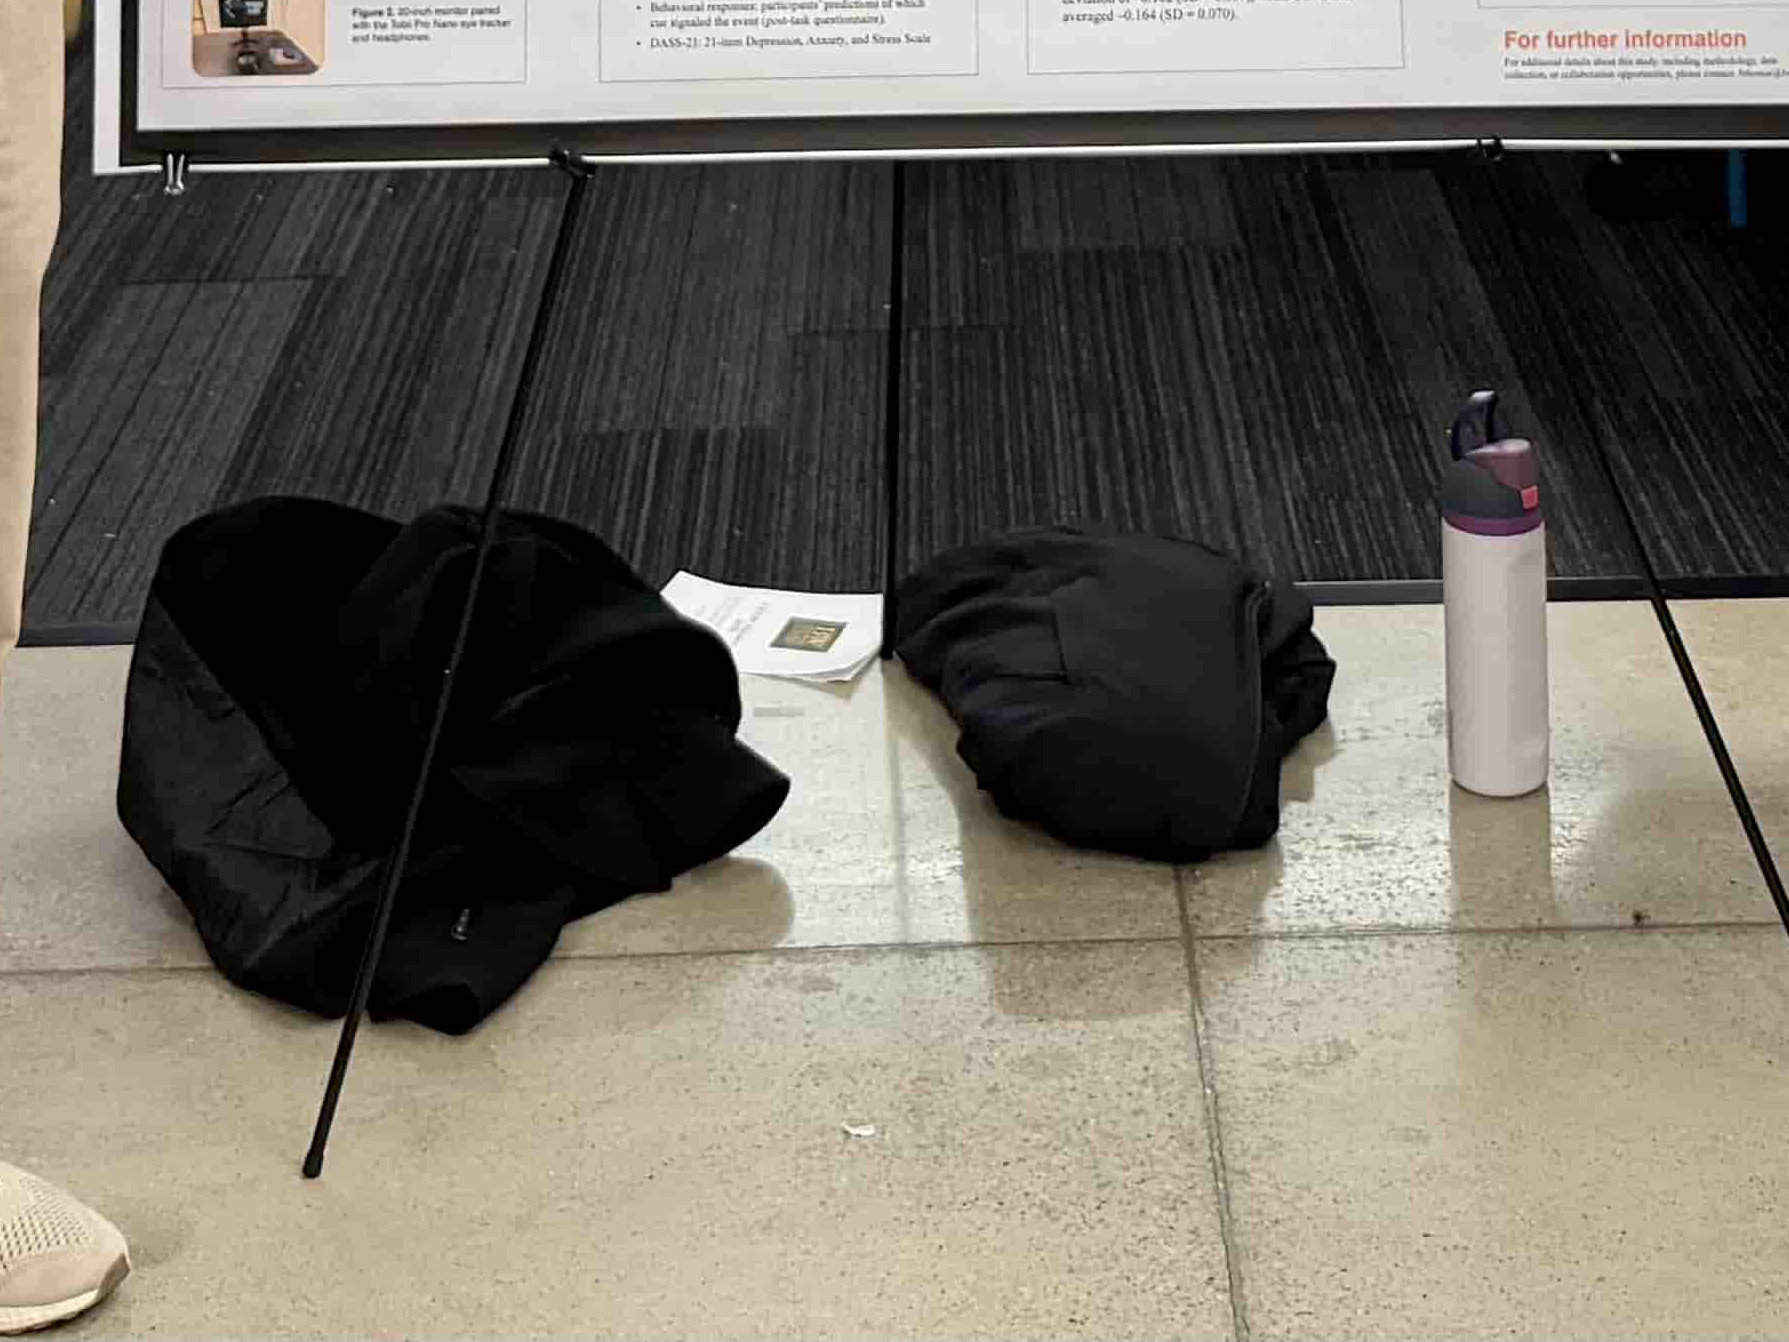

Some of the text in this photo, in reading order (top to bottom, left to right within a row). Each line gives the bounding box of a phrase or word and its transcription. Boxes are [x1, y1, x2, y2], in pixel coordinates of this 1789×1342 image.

[1504, 27, 1748, 51] For further information
